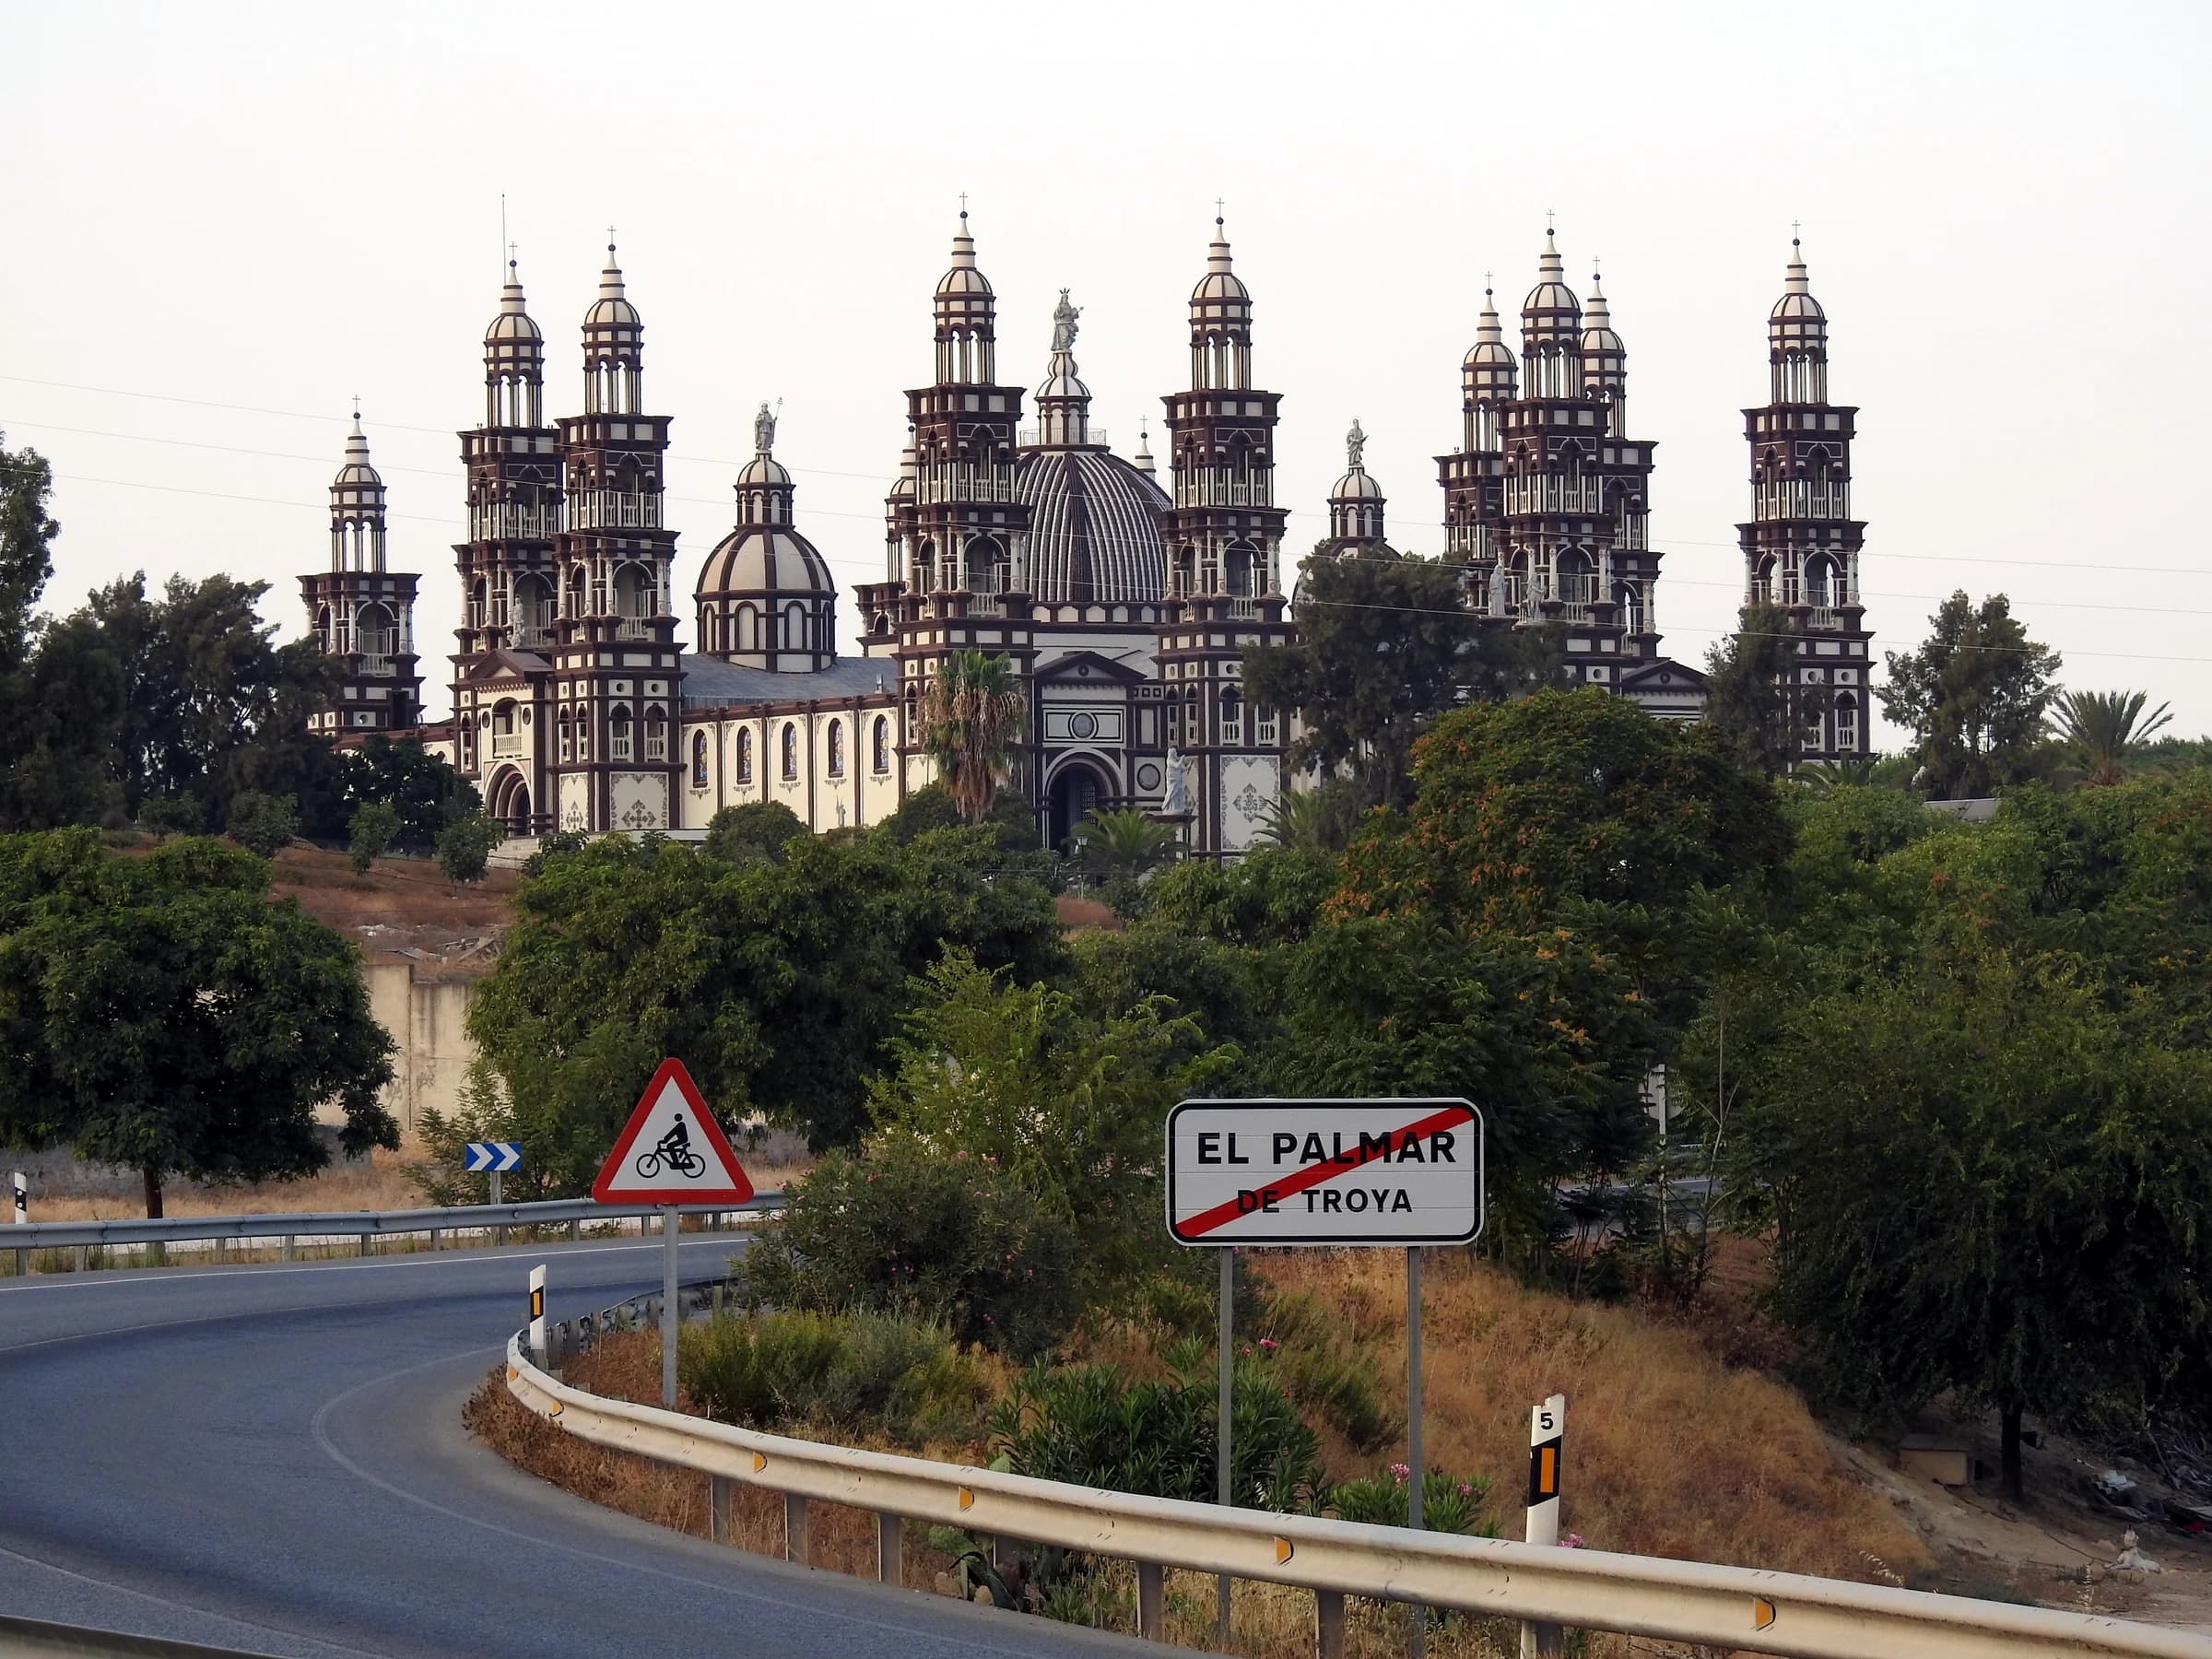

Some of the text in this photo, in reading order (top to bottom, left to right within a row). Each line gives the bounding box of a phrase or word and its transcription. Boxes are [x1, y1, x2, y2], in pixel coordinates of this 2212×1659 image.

[1197, 1131, 1456, 1165] EL PALMAR
[1237, 1188, 1413, 1214] DE TROYA
[1540, 1412, 1554, 1430] 5
